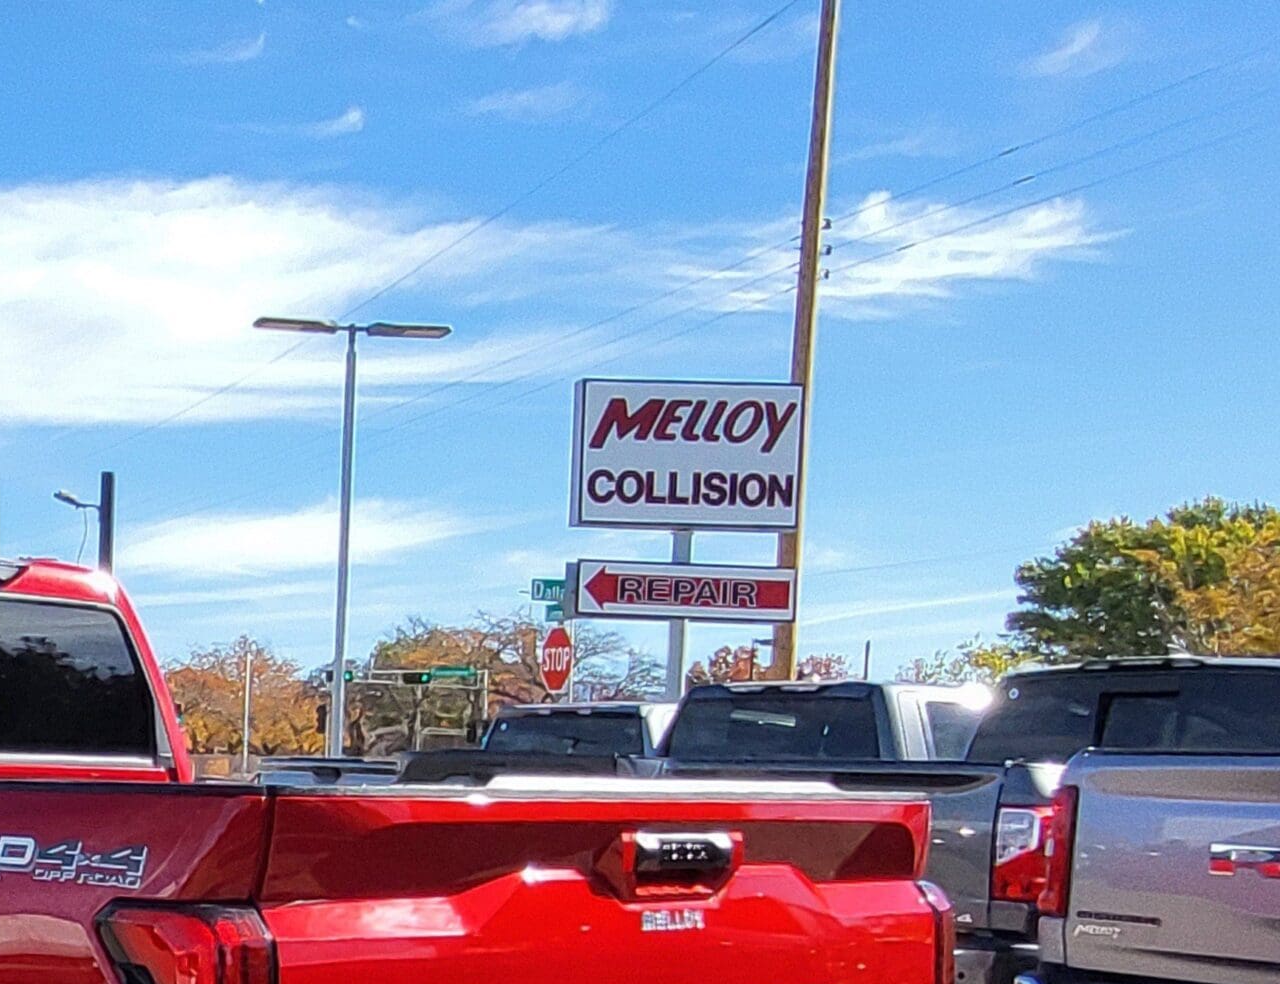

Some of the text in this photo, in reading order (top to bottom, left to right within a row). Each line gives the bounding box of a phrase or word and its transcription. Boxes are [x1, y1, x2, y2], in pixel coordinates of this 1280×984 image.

[588, 397, 797, 453] MELLOY
[587, 469, 794, 507] COLLISION
[618, 576, 757, 607] REPAIR
[543, 646, 570, 672] STOP
